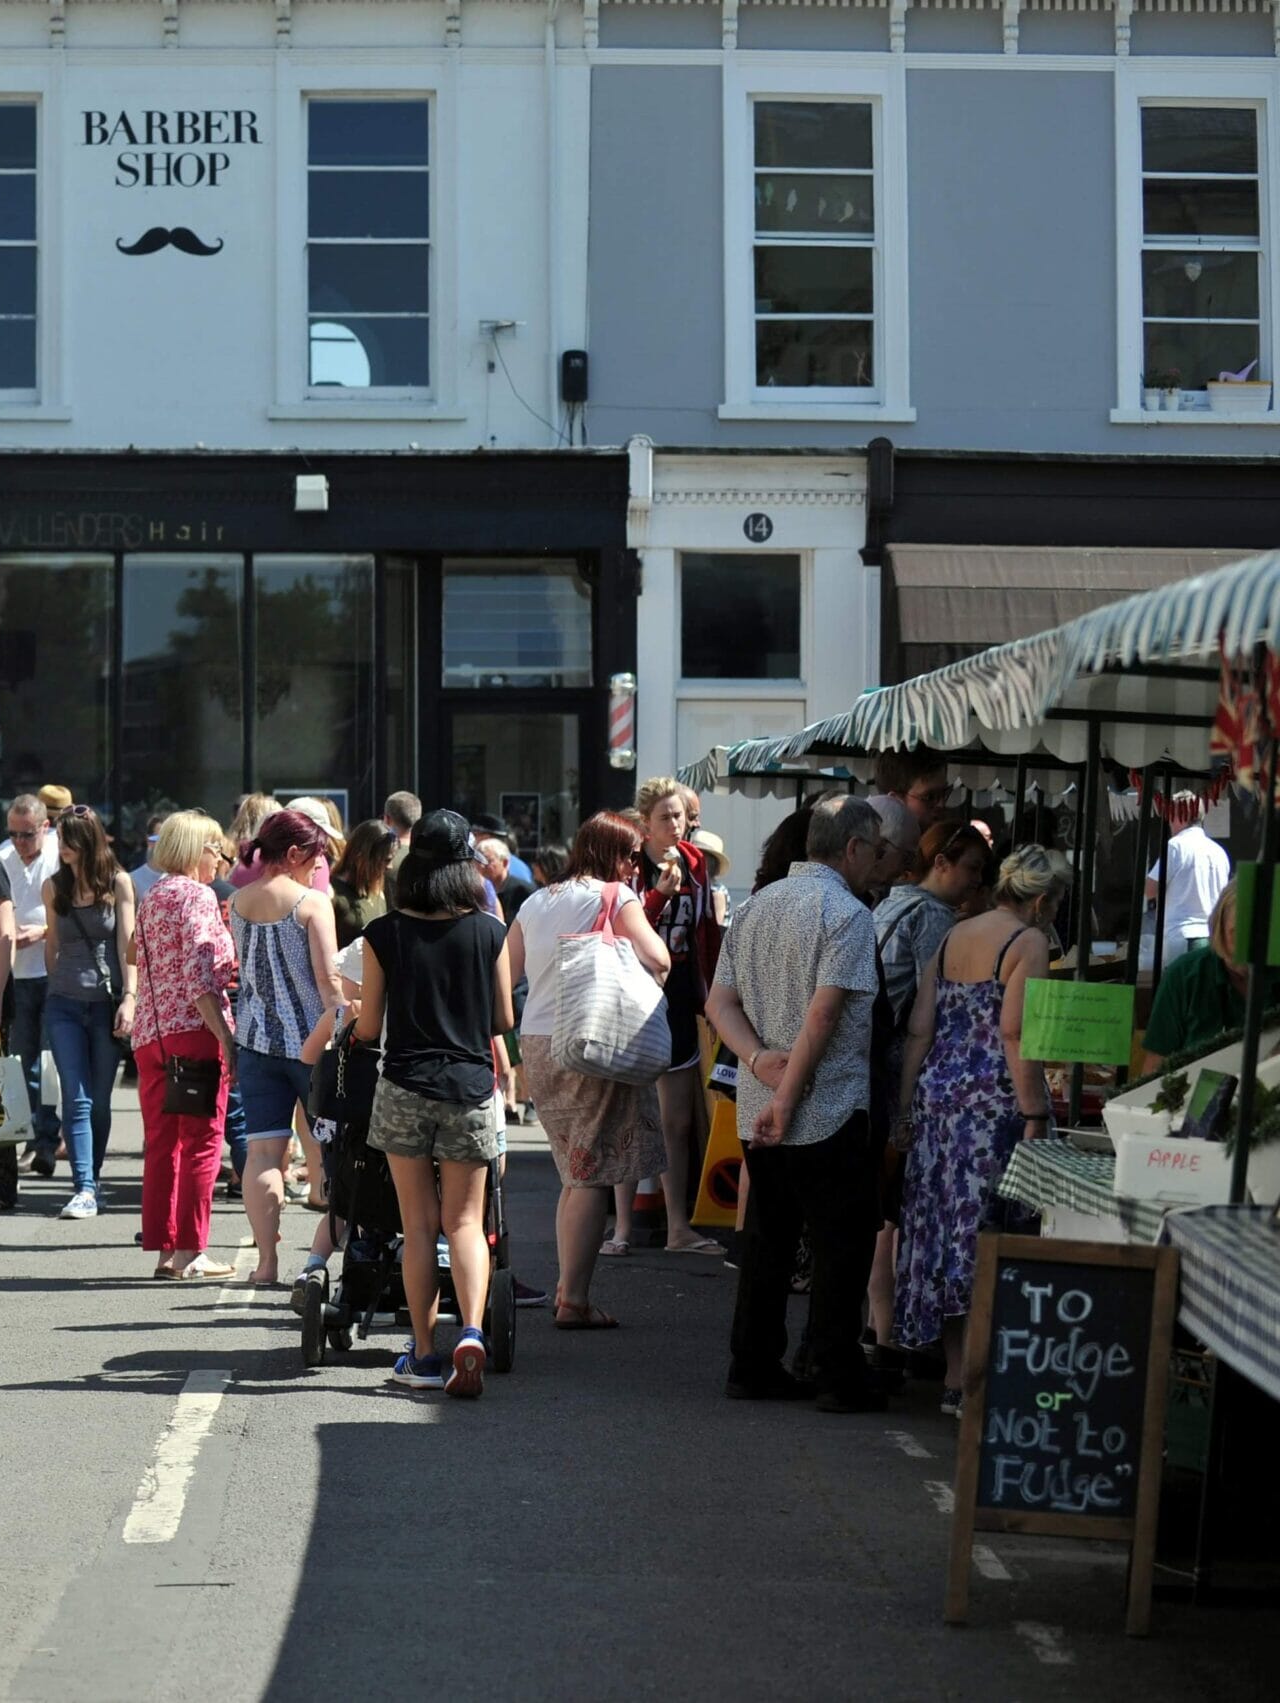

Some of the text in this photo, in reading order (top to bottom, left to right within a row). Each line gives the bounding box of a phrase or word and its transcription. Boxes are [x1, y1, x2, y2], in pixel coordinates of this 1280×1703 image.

[80, 110, 263, 146] BARBER
[115, 152, 230, 188] SHOP
[748, 515, 769, 537] 14
[1147, 1148, 1202, 1173] APPLE
[1035, 1391, 1073, 1411] or
[1073, 1411, 1126, 1458] to
